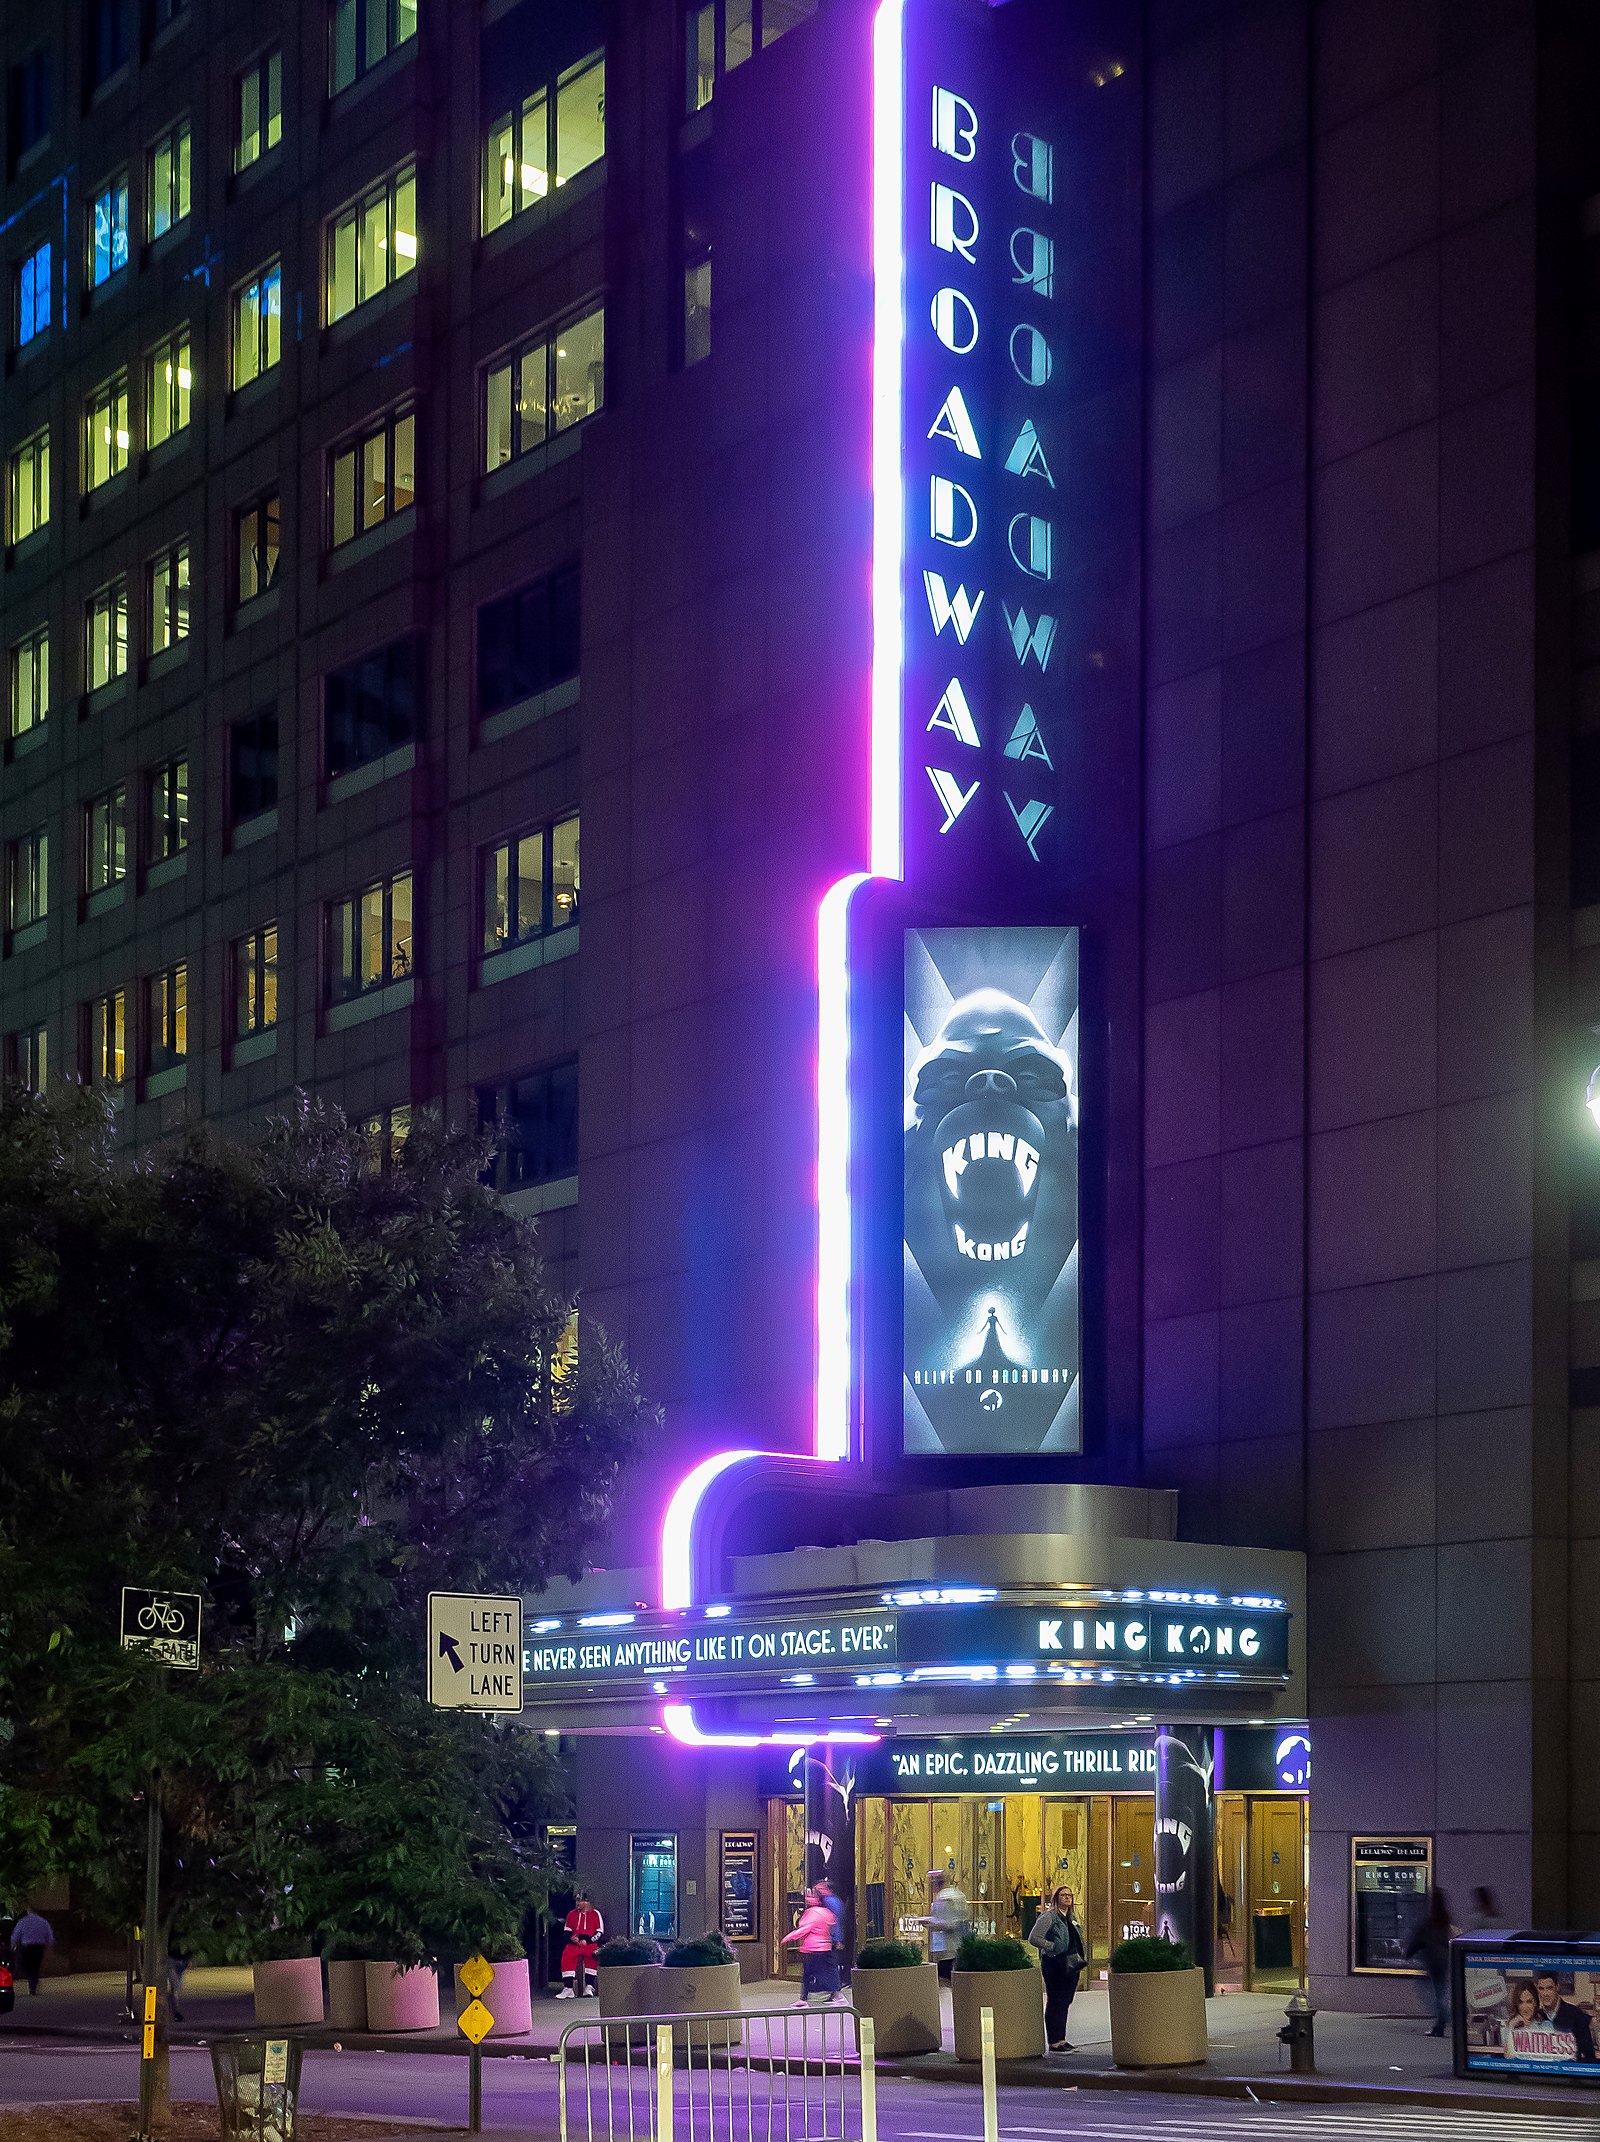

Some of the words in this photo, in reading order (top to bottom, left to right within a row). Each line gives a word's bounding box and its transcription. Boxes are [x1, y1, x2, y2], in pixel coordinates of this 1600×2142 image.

[924, 84, 985, 834] BROADWAY
[942, 1131, 1041, 1200] KING
[954, 1220, 1029, 1261] KONG
[914, 1369, 956, 1385] ALIVE
[965, 1369, 983, 1384] ON
[992, 1368, 1070, 1384] BROADWAY
[470, 1611, 512, 1633] LEFT
[1039, 1620, 1147, 1651] KING
[1167, 1624, 1261, 1656] KONG
[469, 1642, 515, 1665] TURN
[533, 1648, 577, 1672] NEVER
[579, 1644, 611, 1669] SEEN
[614, 1639, 692, 1666] ANYTHING
[695, 1636, 726, 1661] LIKE
[730, 1634, 744, 1659] IT
[748, 1633, 776, 1658] ON
[780, 1628, 836, 1657] STAGE.
[470, 1674, 514, 1696] LANE
[925, 1752, 969, 1777] EPIC,
[974, 1750, 1060, 1775] DAZZLING
[1063, 1749, 1122, 1773] THRILL
[1128, 1749, 1157, 1772] RID
[805, 1830, 834, 1864] ING
[1153, 1817, 1193, 1856] ING
[1512, 2030, 1577, 2056] WAITRESS
